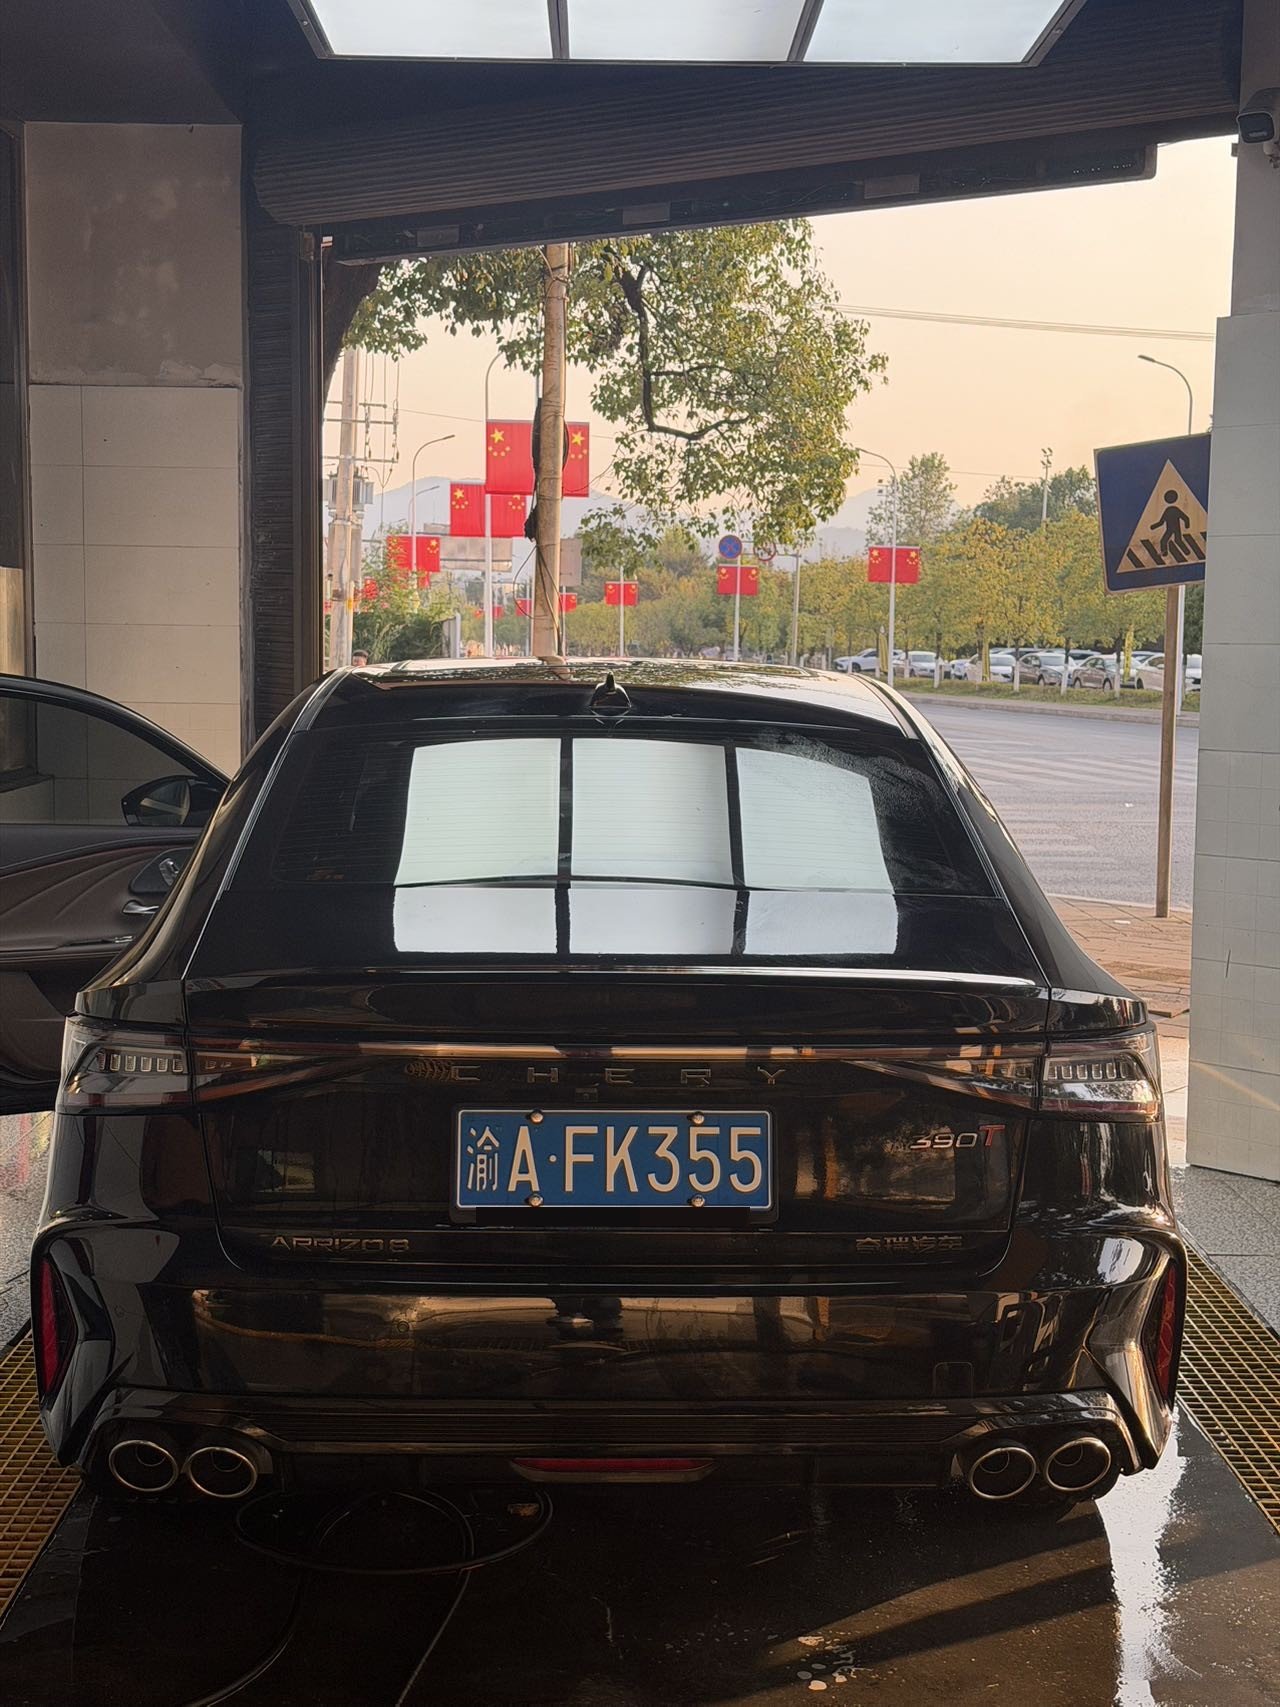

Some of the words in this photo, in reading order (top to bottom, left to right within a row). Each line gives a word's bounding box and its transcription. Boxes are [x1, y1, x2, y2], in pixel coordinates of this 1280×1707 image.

[452, 1066, 786, 1085] CHERY
[910, 1124, 1005, 1149] 390T
[467, 1125, 763, 1193] 渝A·FK355
